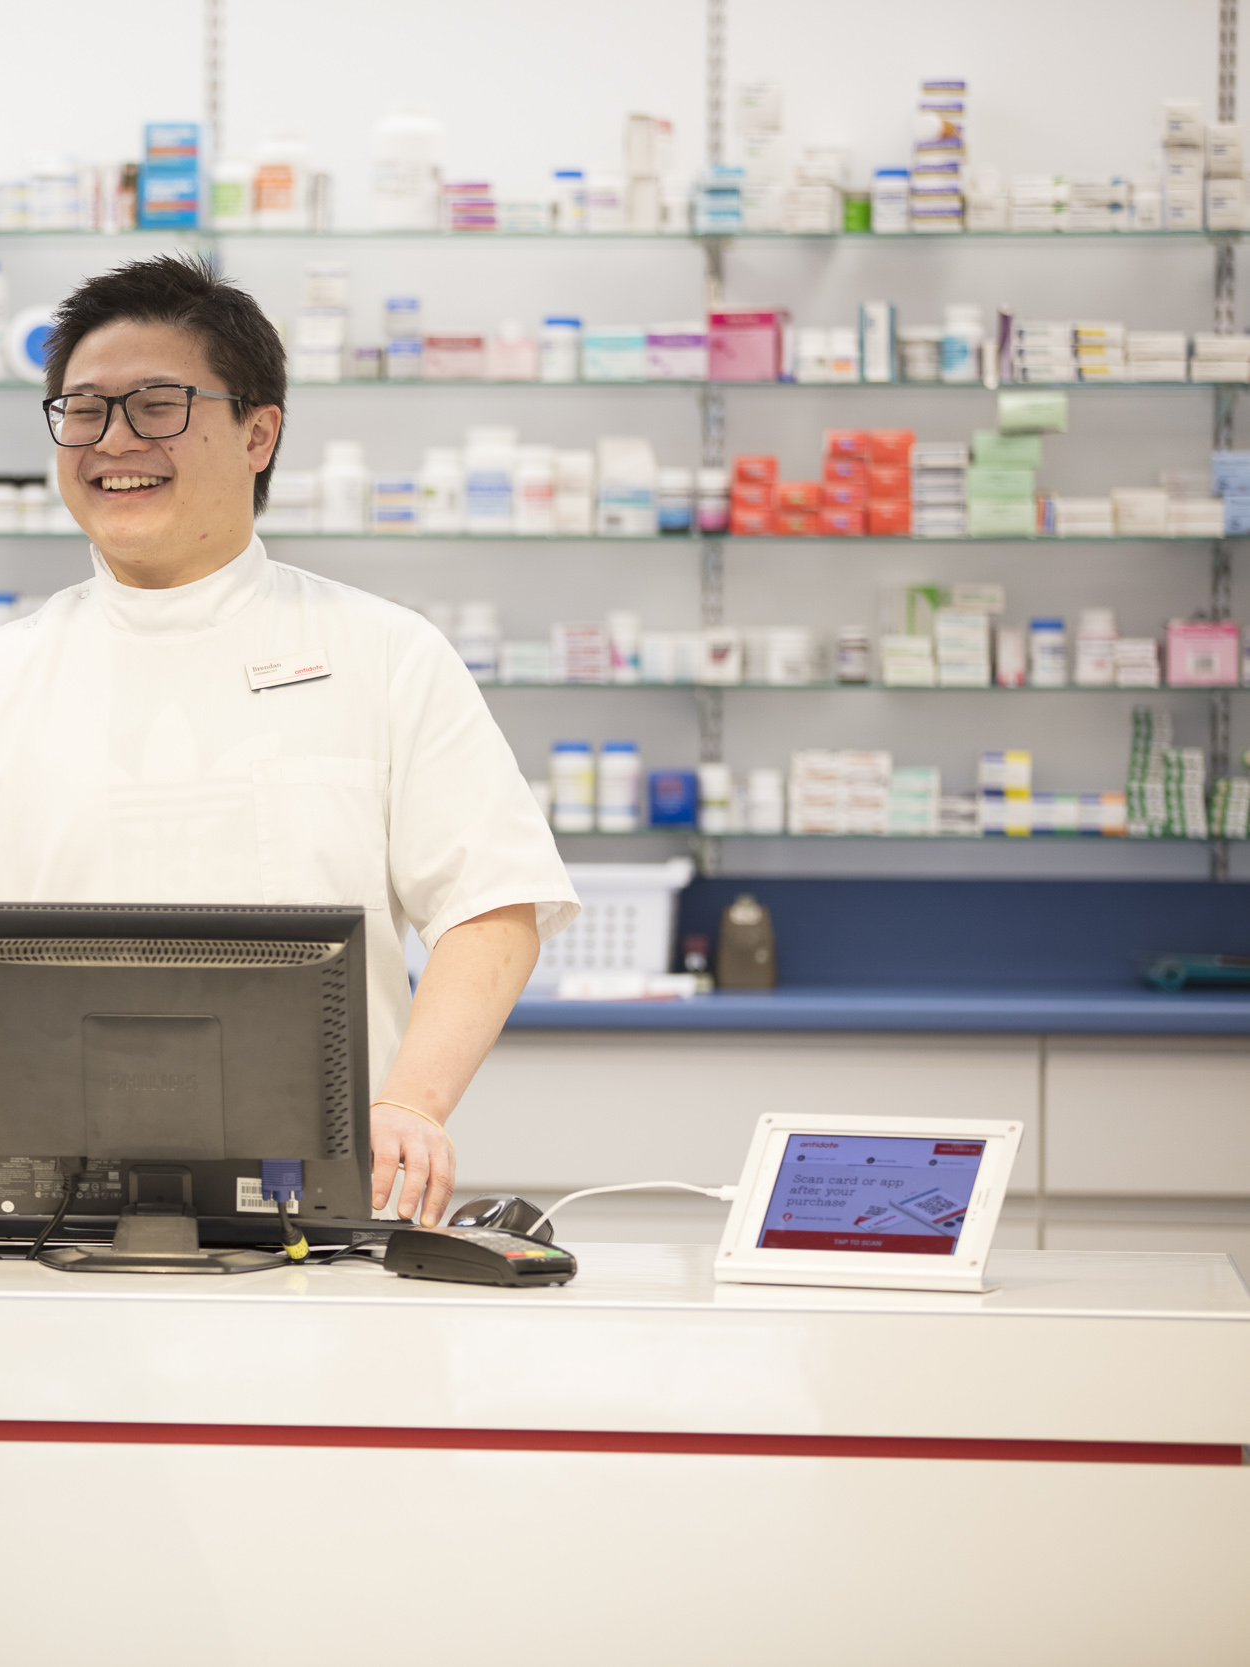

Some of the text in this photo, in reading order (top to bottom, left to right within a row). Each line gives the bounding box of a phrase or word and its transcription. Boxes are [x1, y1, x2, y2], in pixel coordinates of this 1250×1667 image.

[252, 663, 281, 672] Brendan
[294, 665, 323, 674] antidote
[110, 1074, 198, 1091] PHILIPS
[793, 1175, 824, 1185] Scan
[828, 1176, 858, 1186] card
[880, 1179, 904, 1188] app
[790, 1186, 856, 1198] after your
[786, 1198, 846, 1207] purchase
